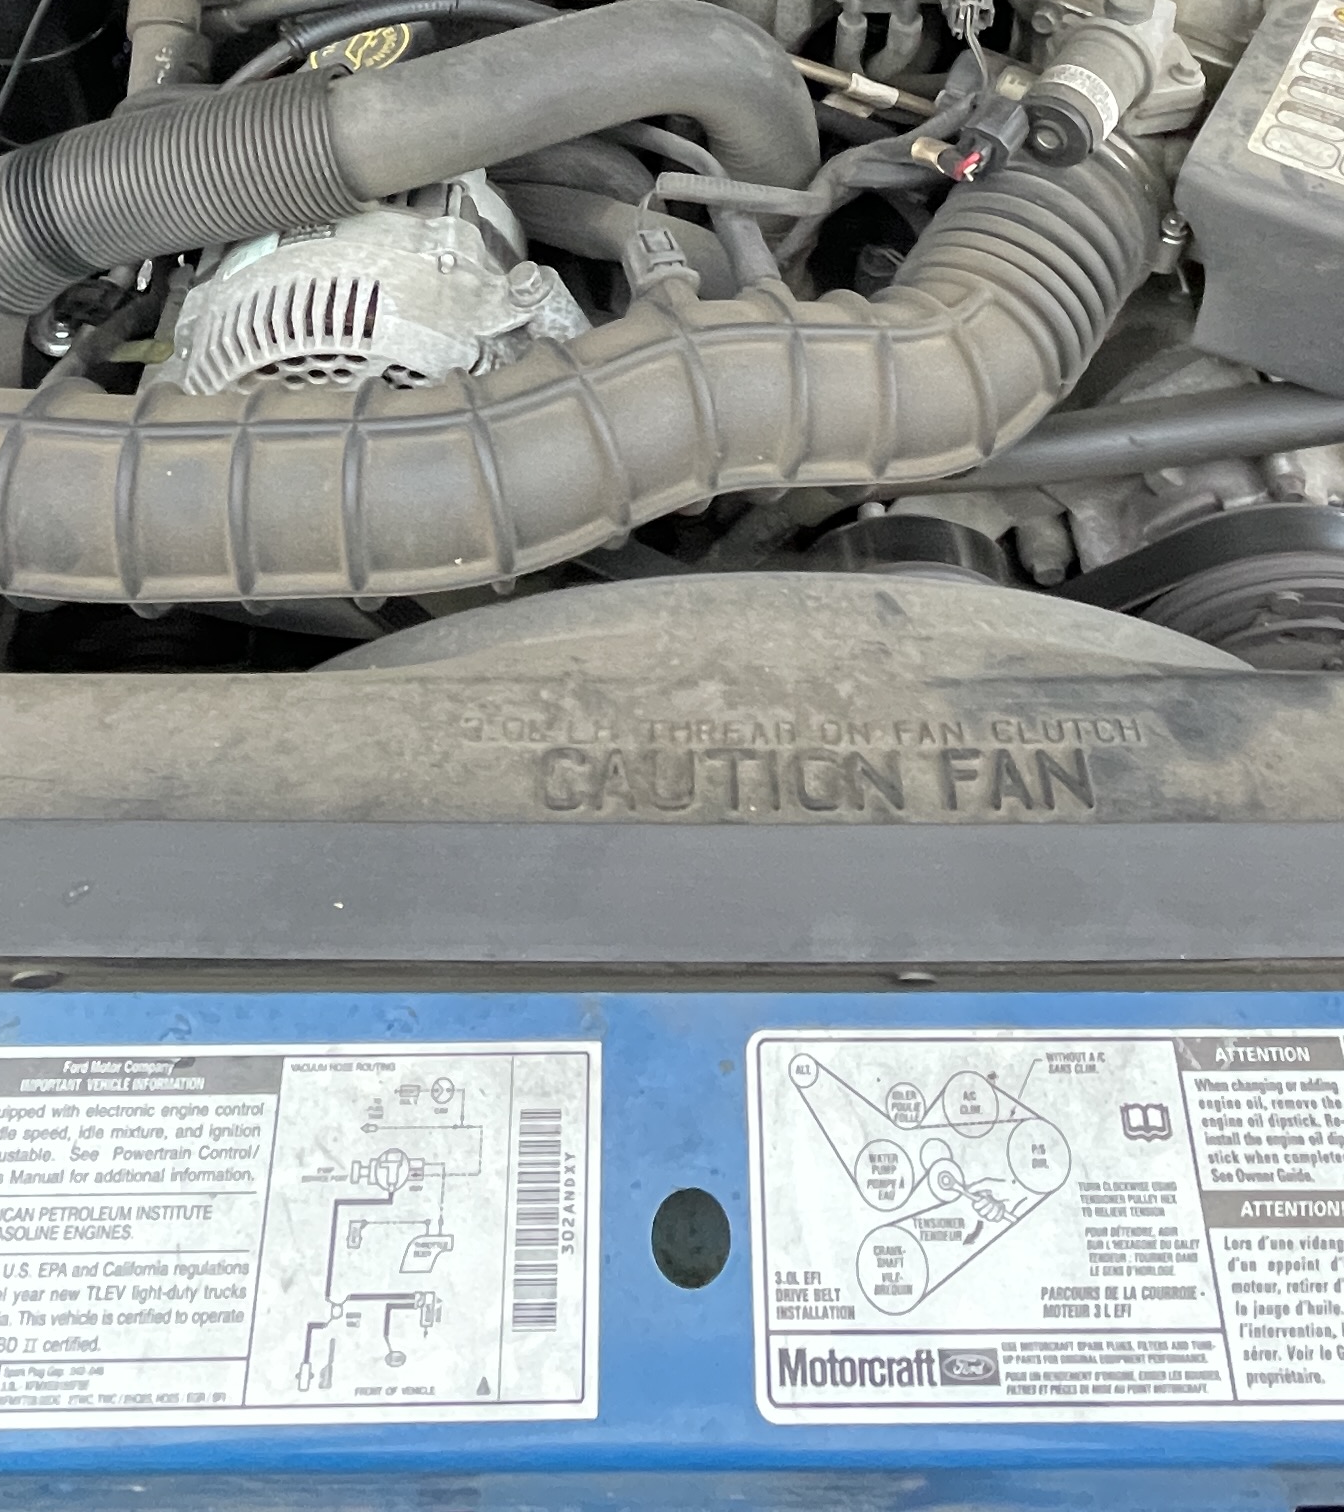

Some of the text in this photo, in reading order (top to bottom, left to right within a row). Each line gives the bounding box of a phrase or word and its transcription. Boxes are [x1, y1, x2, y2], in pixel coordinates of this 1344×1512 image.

[821, 720, 872, 744] ON
[892, 720, 965, 745] FAN
[991, 719, 1142, 745] CLUTCH
[541, 746, 1095, 812] CAUTION FAN
[1215, 1046, 1311, 1063] ATTENTION
[63, 1061, 89, 1074] Ford
[87, 1078, 130, 1092] VEHICLE
[52, 1104, 80, 1118] with
[86, 1103, 155, 1118] electronic
[161, 1103, 209, 1120] engine
[215, 1102, 265, 1116] control
[23, 1126, 71, 1144] speed,
[79, 1125, 104, 1139] idle
[111, 1125, 168, 1140] mixture,
[176, 1125, 203, 1138] and
[209, 1124, 261, 1141] ignition
[70, 1146, 100, 1162] See
[113, 1146, 191, 1161] Powertrain
[199, 1145, 260, 1160] Control/
[10, 1170, 65, 1184] Manual
[70, 1169, 90, 1183] for
[94, 1168, 166, 1183] additional
[171, 1167, 255, 1182] information.
[561, 1151, 576, 1255] 302ANDXY
[39, 1205, 132, 1222] PETROLEUM
[136, 1205, 213, 1220] INSTITUTE
[63, 1224, 134, 1240] ENGINES.
[3, 1262, 32, 1279] U.S.
[38, 1262, 67, 1277] EPA
[72, 1262, 99, 1277] and
[103, 1261, 168, 1277] California
[173, 1259, 250, 1280] regulations
[775, 1271, 821, 1285] 3.0L EFI
[12, 1288, 45, 1306] year
[50, 1289, 80, 1301] new
[87, 1285, 127, 1301] TLEV
[132, 1285, 198, 1304] light-duty
[204, 1283, 247, 1299] trucks
[776, 1288, 841, 1303] DRIVE BELT
[1041, 1285, 1100, 1301] PARCOURS
[1105, 1285, 1119, 1300] DE
[1123, 1286, 1137, 1300] LA
[18, 1310, 46, 1327] This
[51, 1310, 98, 1326] vehicle
[102, 1309, 114, 1325] is
[117, 1308, 173, 1325] certified
[175, 1310, 188, 1324] to
[192, 1309, 245, 1327] operate
[776, 1305, 856, 1321] INSTALLATION
[1043, 1303, 1132, 1318] MOTEUR 3 L EFI
[43, 1336, 101, 1352] certified.
[778, 1348, 938, 1387] Motorcraft
